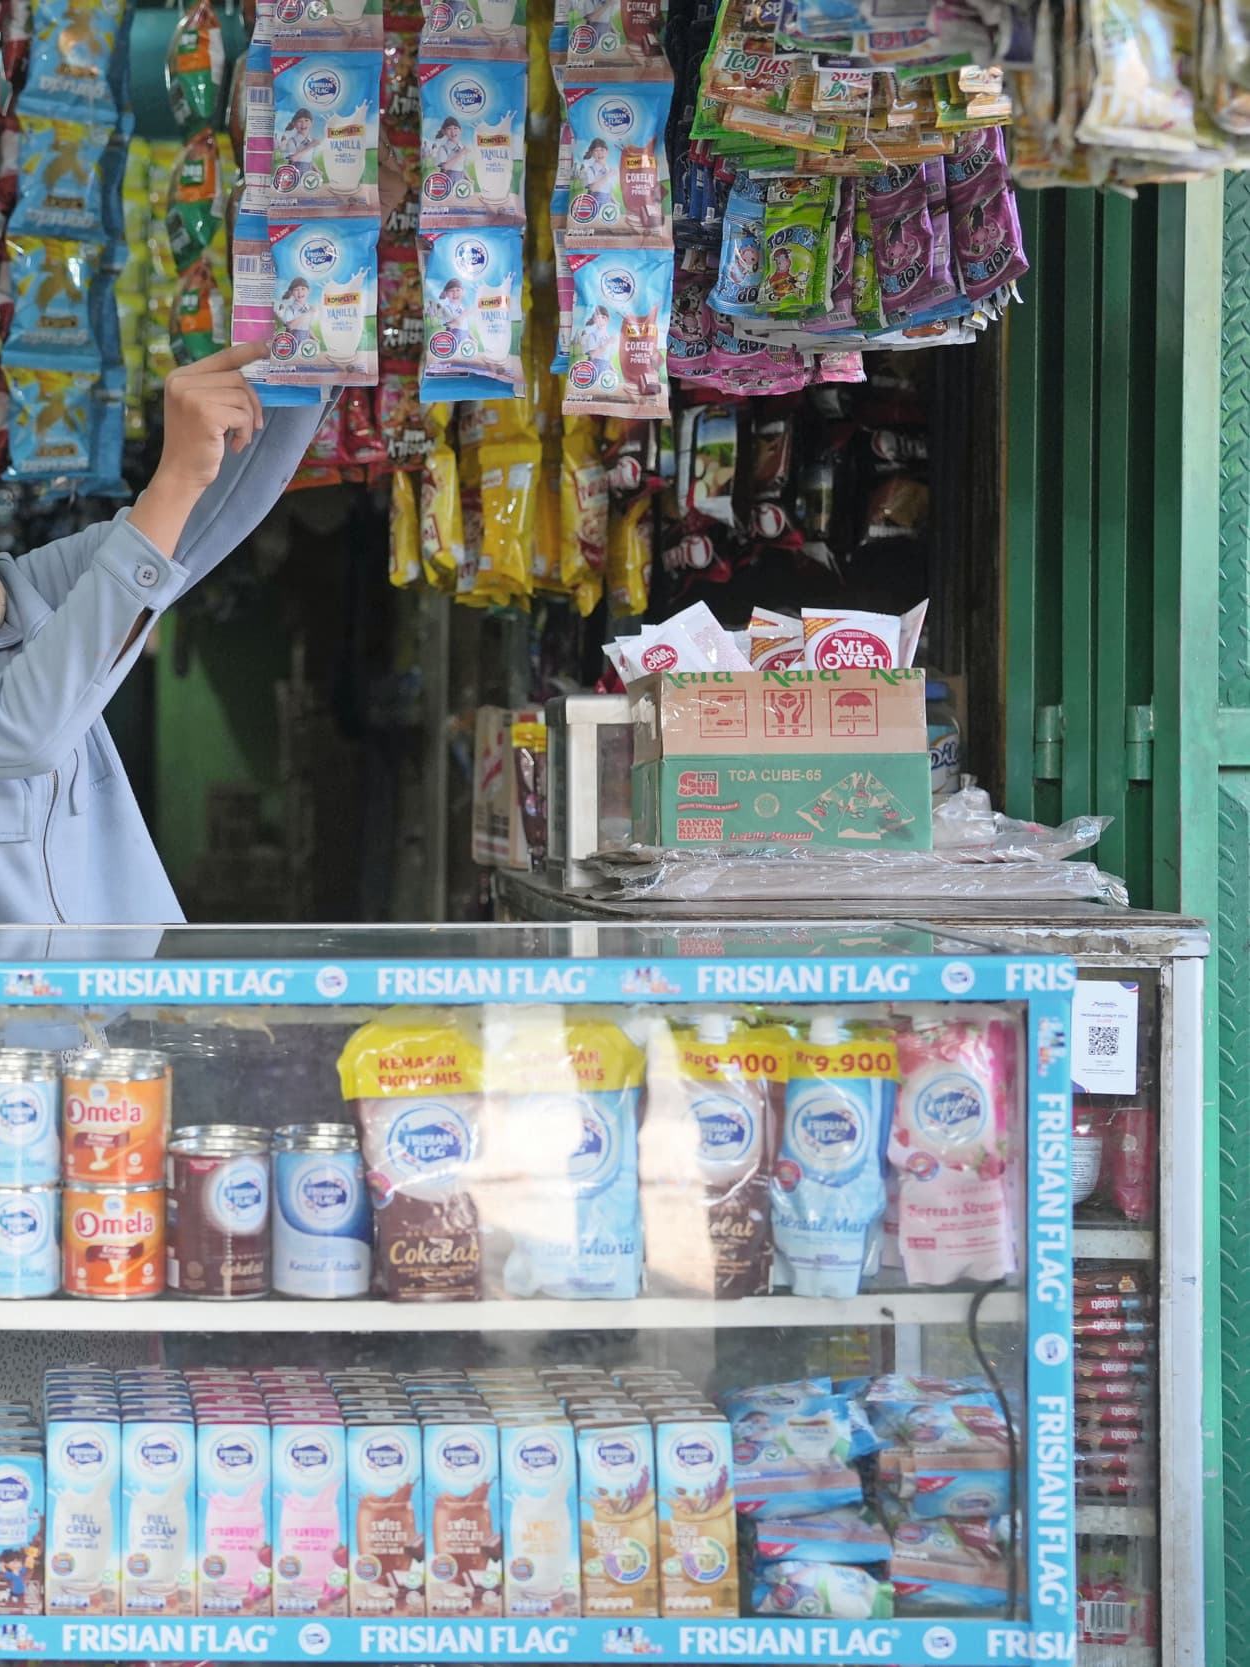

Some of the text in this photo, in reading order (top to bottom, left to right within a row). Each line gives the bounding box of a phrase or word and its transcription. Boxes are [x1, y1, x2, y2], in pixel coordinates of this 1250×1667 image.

[724, 49, 791, 77] Teajus
[330, 140, 361, 151] VANILLA
[645, 647, 667, 661] Mie
[832, 638, 875, 657] Mie
[822, 651, 885, 669] Oven
[678, 771, 718, 796] SUN
[728, 770, 822, 782] TCA CUBE-65
[678, 819, 722, 827] SANTAN
[729, 831, 814, 841] Lebih Kental
[78, 967, 201, 996] FRISIAN
[377, 966, 502, 995] FRISIAN
[697, 965, 825, 993] FRISIAN
[378, 1056, 456, 1070] KEMASAN
[378, 1071, 463, 1088] EKONOMIS
[66, 1098, 142, 1124] Omela
[807, 1119, 850, 1131] FRISIAN
[405, 1132, 454, 1146] FRISIAN
[814, 1130, 843, 1141] FLAG
[413, 1145, 447, 1158] FLAG
[1037, 1094, 1066, 1218] FRISIAN
[75, 1211, 154, 1237] Omela
[390, 1238, 480, 1265] Cokelat
[1037, 1395, 1067, 1520] FRISIAN
[71, 1514, 94, 1525] FULL
[146, 1514, 169, 1525] FULL
[66, 1524, 101, 1537] CREAM
[141, 1524, 177, 1537] CREAM
[62, 1624, 185, 1653] FRISIAN
[360, 1625, 484, 1654] FRISIAN
[679, 1627, 805, 1655] FRISIAN
[988, 1629, 1078, 1659] FRISIA
